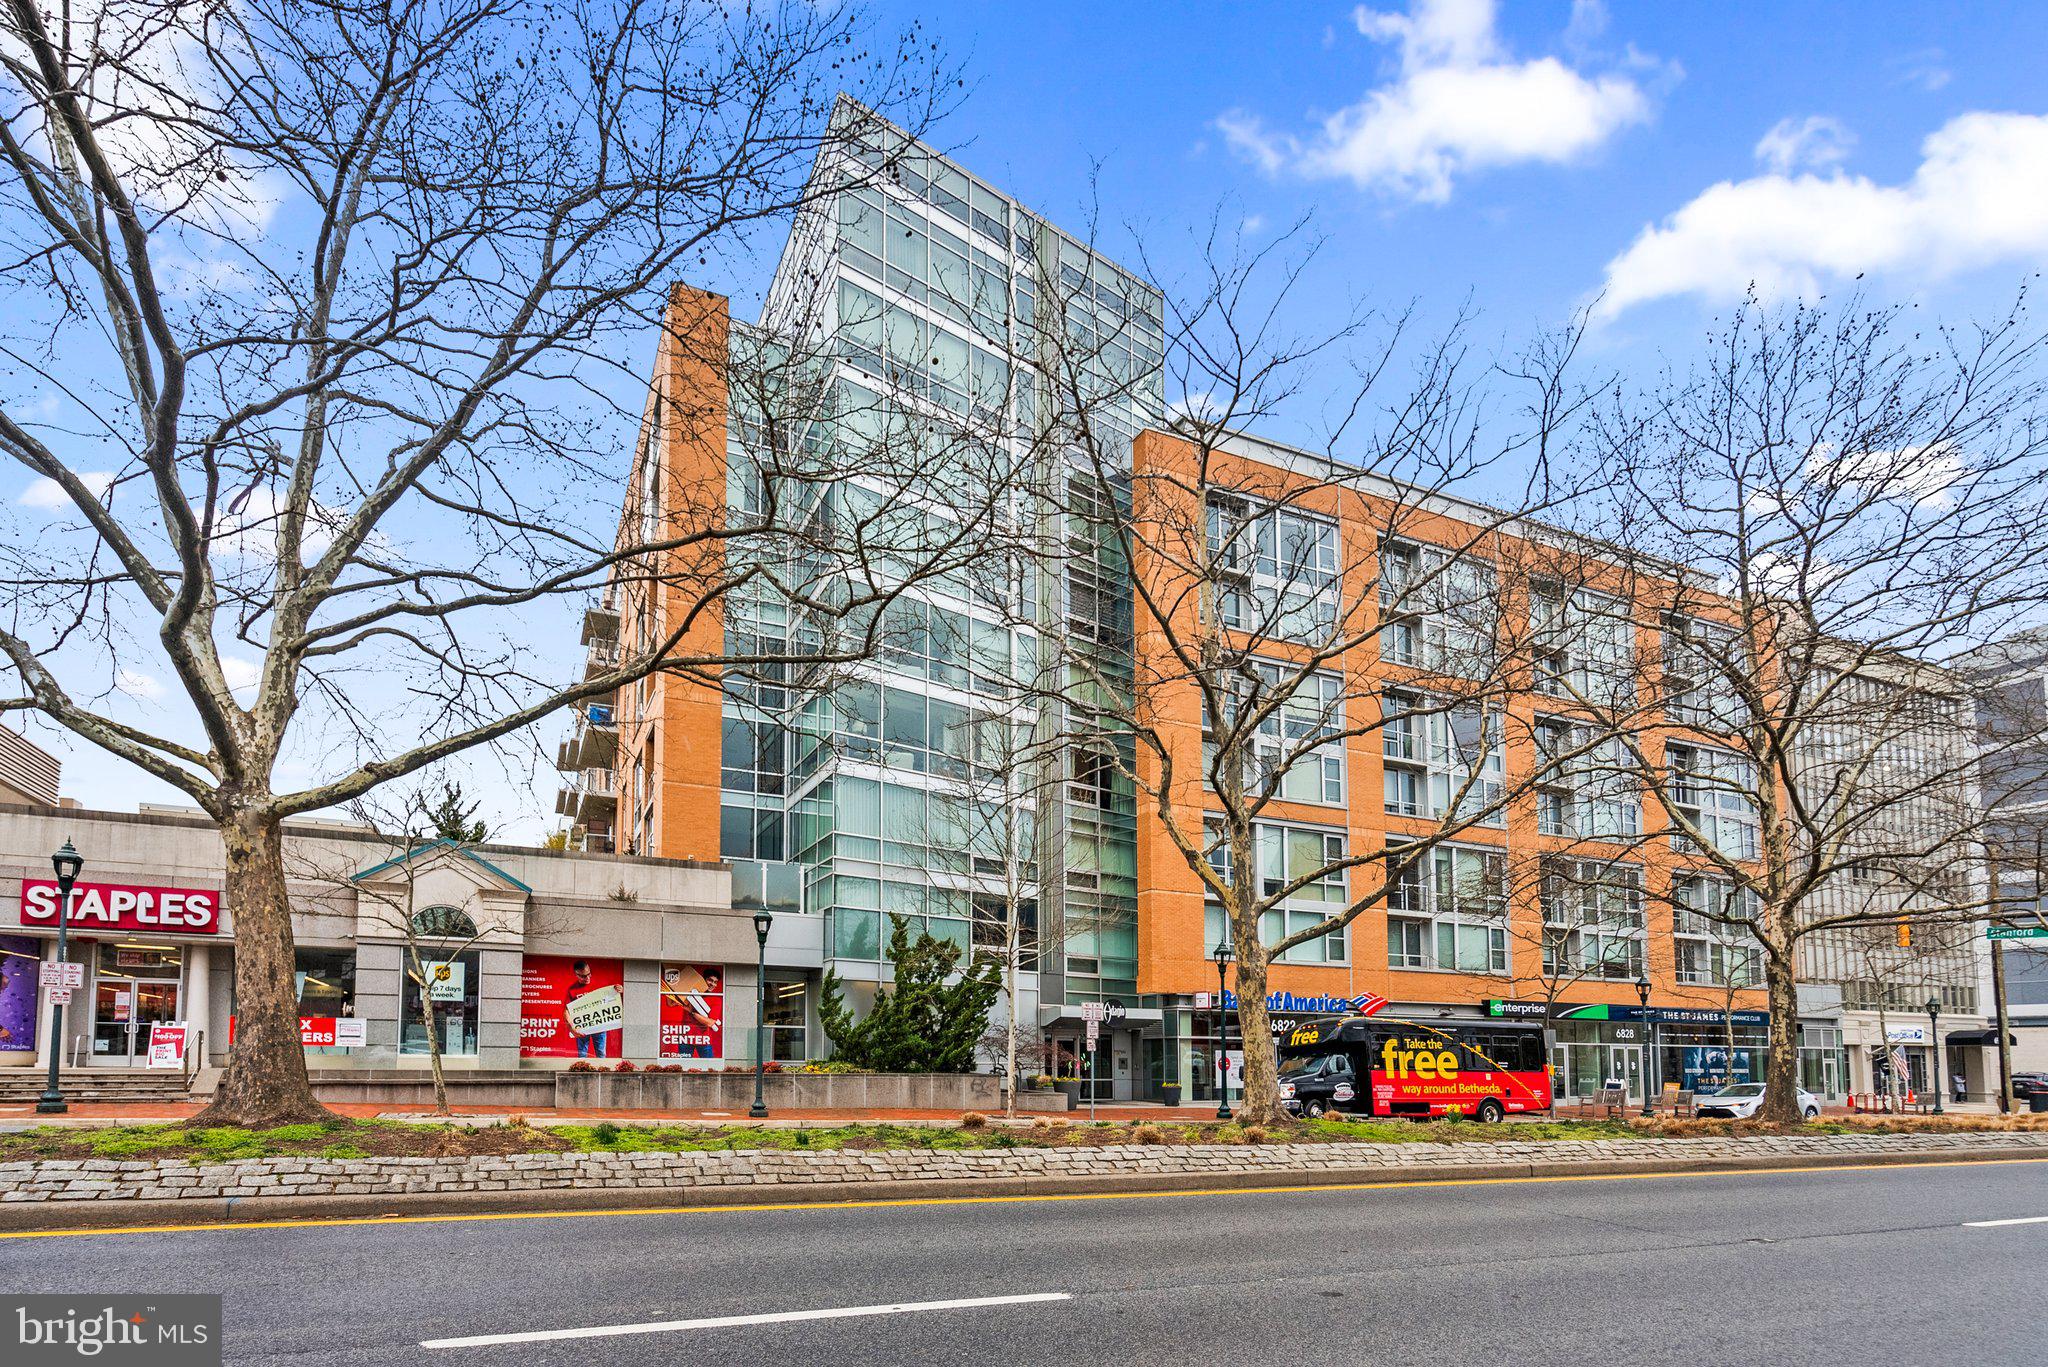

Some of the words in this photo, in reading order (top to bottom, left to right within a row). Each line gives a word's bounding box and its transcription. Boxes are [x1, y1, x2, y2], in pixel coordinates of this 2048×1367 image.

[25, 886, 212, 926] STAPLES
[1990, 929, 2034, 937] Stanford
[445, 985, 462, 993] days
[1283, 992, 1347, 1013] America
[1494, 1003, 1546, 1015] enterprise
[573, 1005, 621, 1024] GRAND
[1662, 1011, 1679, 1020] THE
[1692, 1012, 1719, 1021] JAMES
[521, 1018, 559, 1028] PRINT
[520, 1028, 556, 1038] SHOP
[662, 1024, 691, 1034] SHIP
[1616, 1028, 1634, 1038] 6828
[662, 1035, 711, 1045] CENTER
[1290, 1029, 1319, 1047] free
[1404, 1039, 1426, 1050] Take
[1426, 1040, 1443, 1050] the
[1381, 1038, 1459, 1079] free
[1402, 1086, 1422, 1096] way
[1424, 1084, 1457, 1094] around
[1459, 1082, 1503, 1094] Bethesda.
